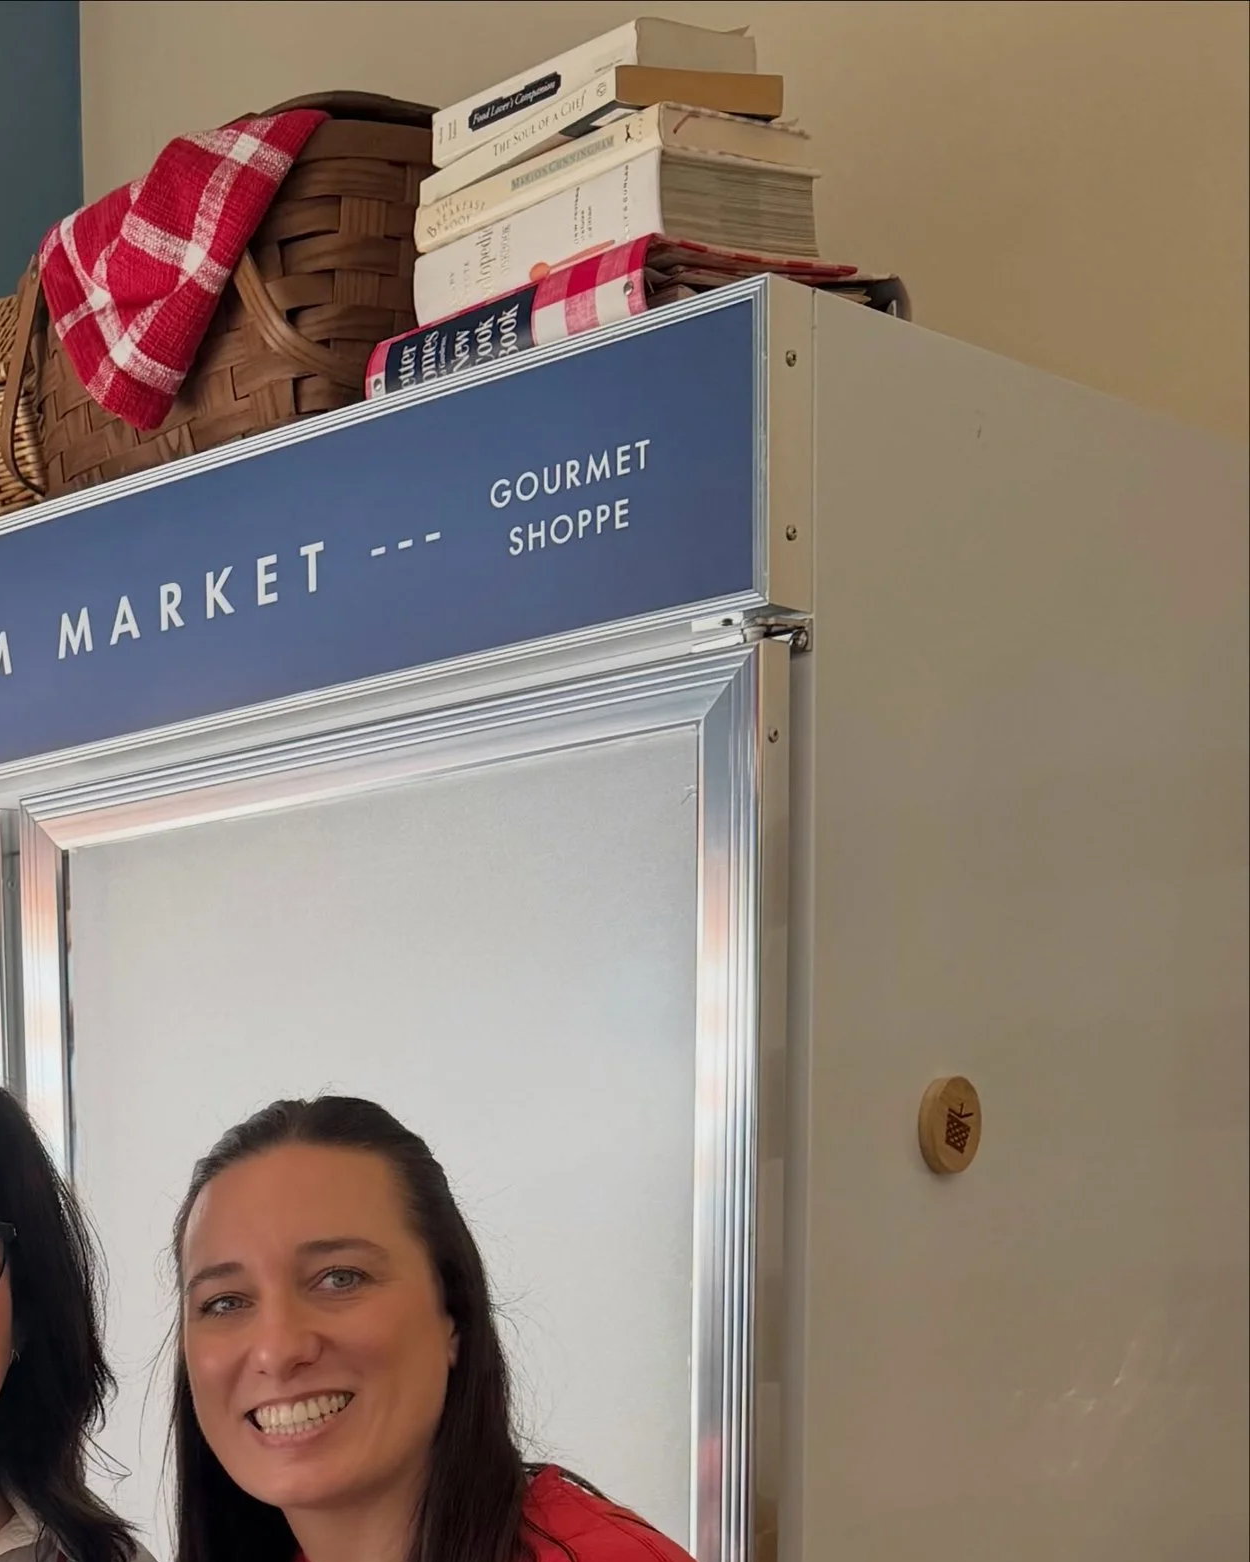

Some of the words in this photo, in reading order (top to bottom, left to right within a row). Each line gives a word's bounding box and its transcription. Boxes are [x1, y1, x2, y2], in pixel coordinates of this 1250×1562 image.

[472, 107, 491, 126] Food
[514, 80, 557, 105] Companion
[493, 138, 511, 156] THE
[513, 127, 536, 145] SOUL
[538, 117, 550, 132] OF
[510, 167, 550, 192] MARION
[549, 135, 615, 172] CUNNINGHAM
[398, 343, 418, 389] etter
[421, 330, 440, 383] omes
[453, 330, 471, 373] New
[490, 438, 650, 508] GOURMET
[509, 498, 630, 556] SHOPPE
[57, 540, 325, 660] MARKET
